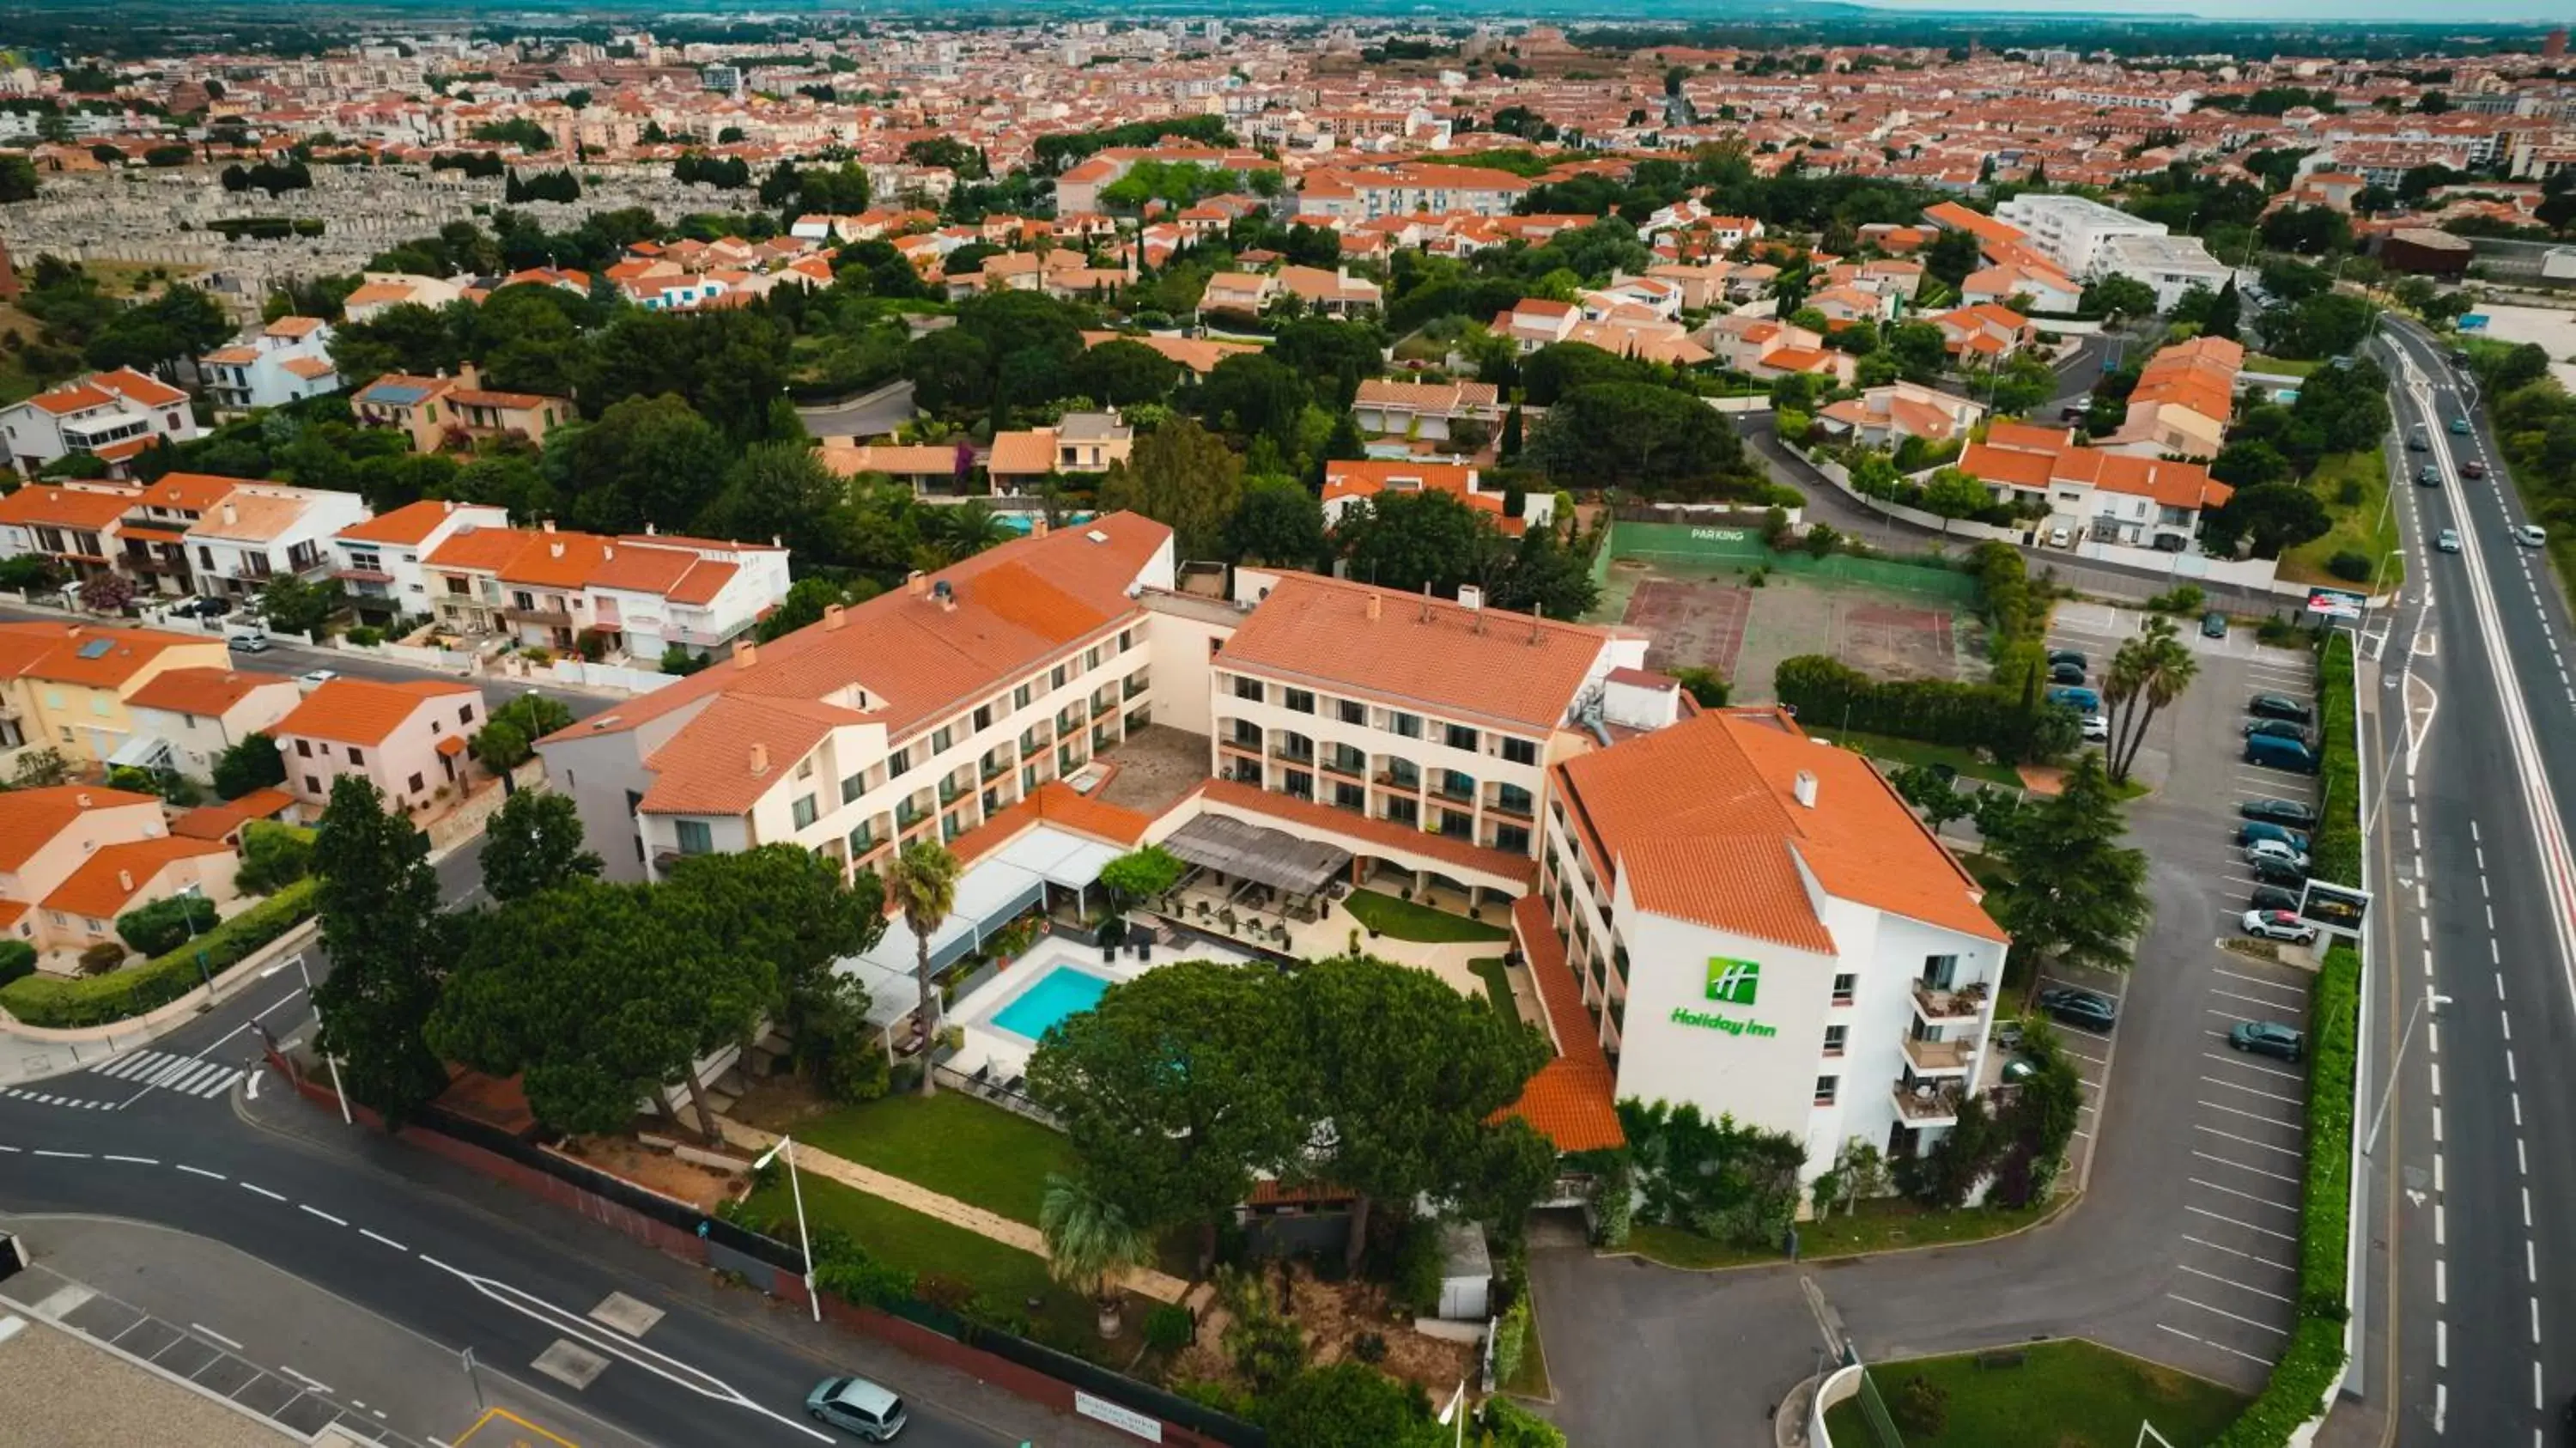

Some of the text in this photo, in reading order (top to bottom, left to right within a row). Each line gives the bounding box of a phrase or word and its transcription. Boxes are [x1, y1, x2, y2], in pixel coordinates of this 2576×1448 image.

[1692, 528, 1744, 541] PARKING
[1671, 1007, 1777, 1037] Holiday Inn
